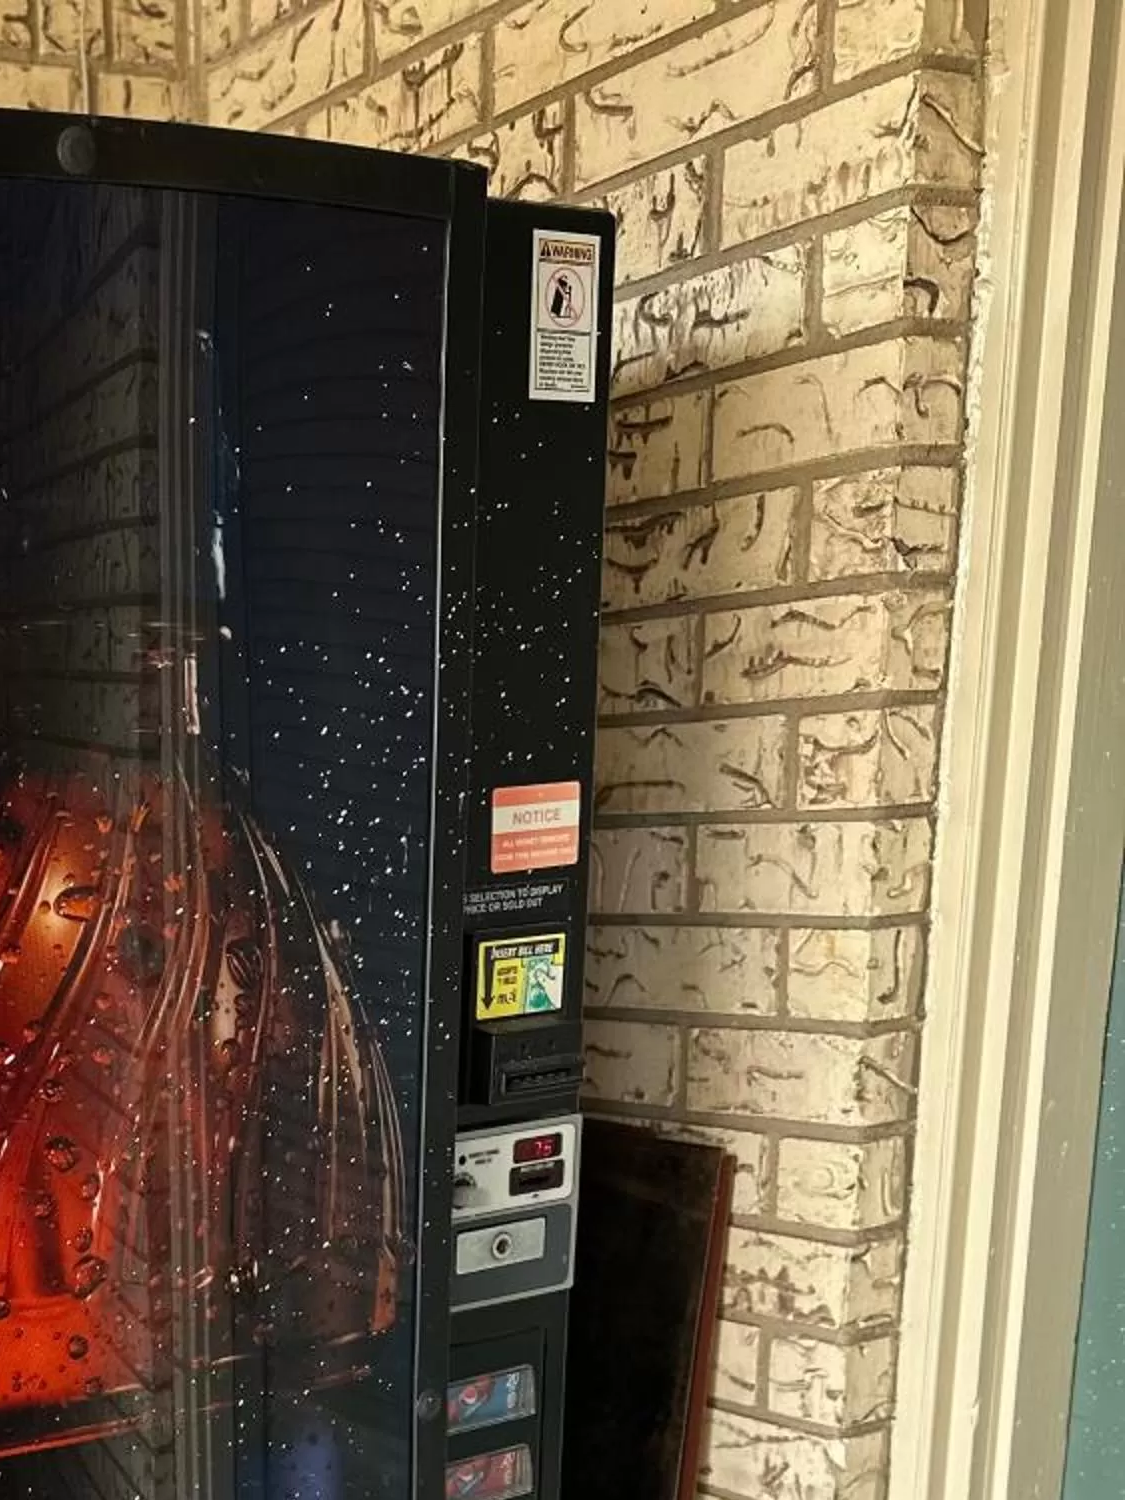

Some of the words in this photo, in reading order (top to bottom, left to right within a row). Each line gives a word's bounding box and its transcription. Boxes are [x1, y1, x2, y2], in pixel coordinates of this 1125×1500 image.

[551, 245, 592, 261] WARNING
[512, 807, 561, 825] NOTICE
[469, 890, 516, 903] SELECTION
[518, 887, 529, 898] TO
[530, 883, 563, 897] DISPLAY
[503, 898, 525, 911] SOLD
[526, 897, 543, 908] OUT
